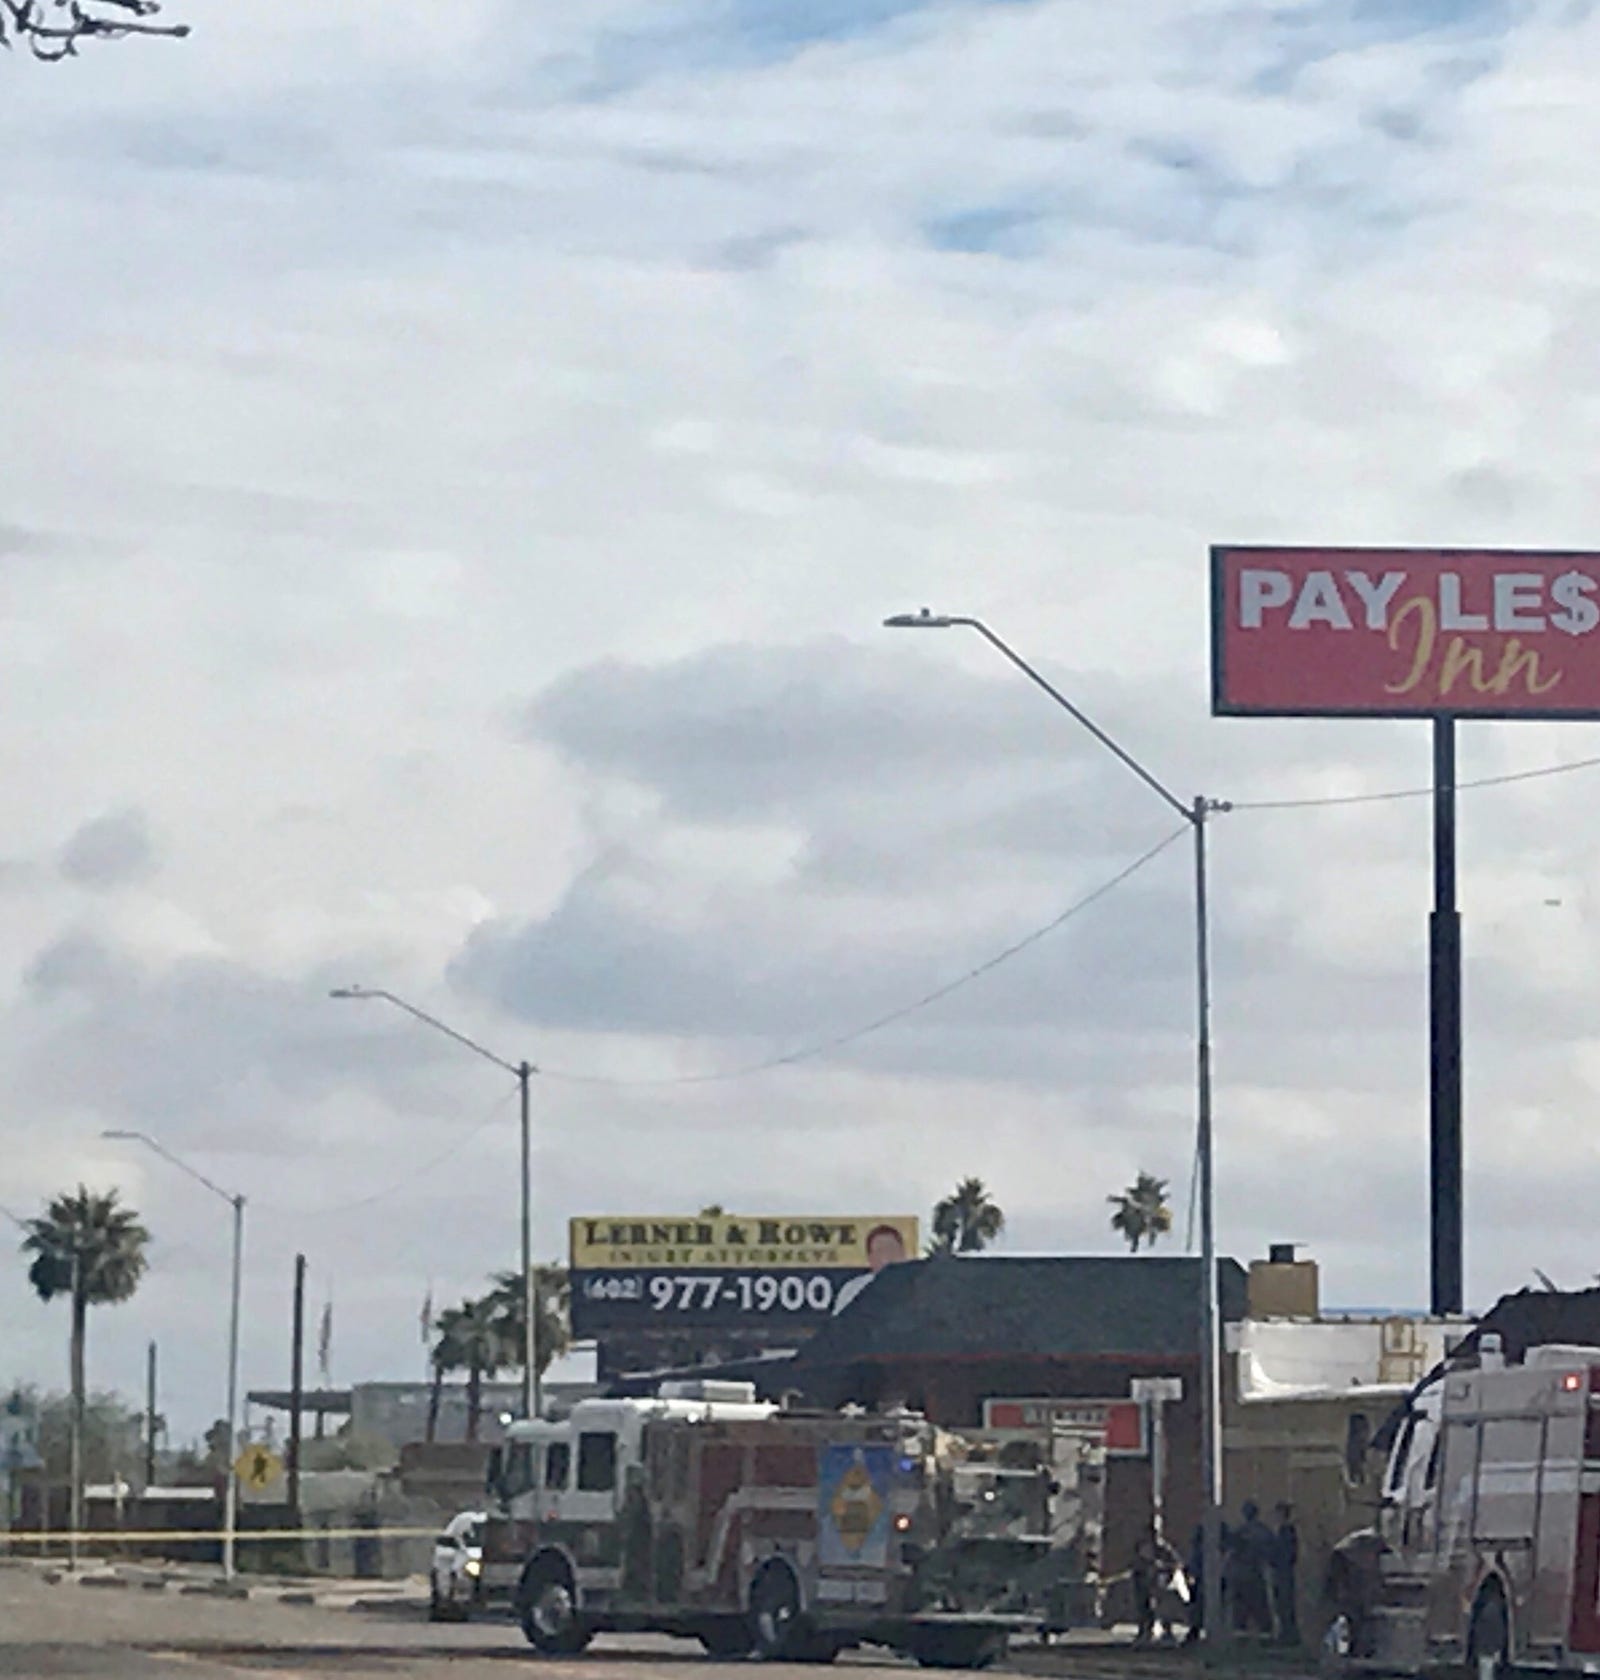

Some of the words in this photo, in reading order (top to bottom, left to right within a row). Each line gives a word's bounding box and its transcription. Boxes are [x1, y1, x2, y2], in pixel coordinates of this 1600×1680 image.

[1239, 568, 1406, 631] PAY
[1384, 596, 1562, 694] Inn
[584, 1220, 713, 1246] LERNER
[726, 1223, 748, 1245] &
[758, 1219, 857, 1246] ROWE
[650, 1274, 833, 1312] 977-1900
